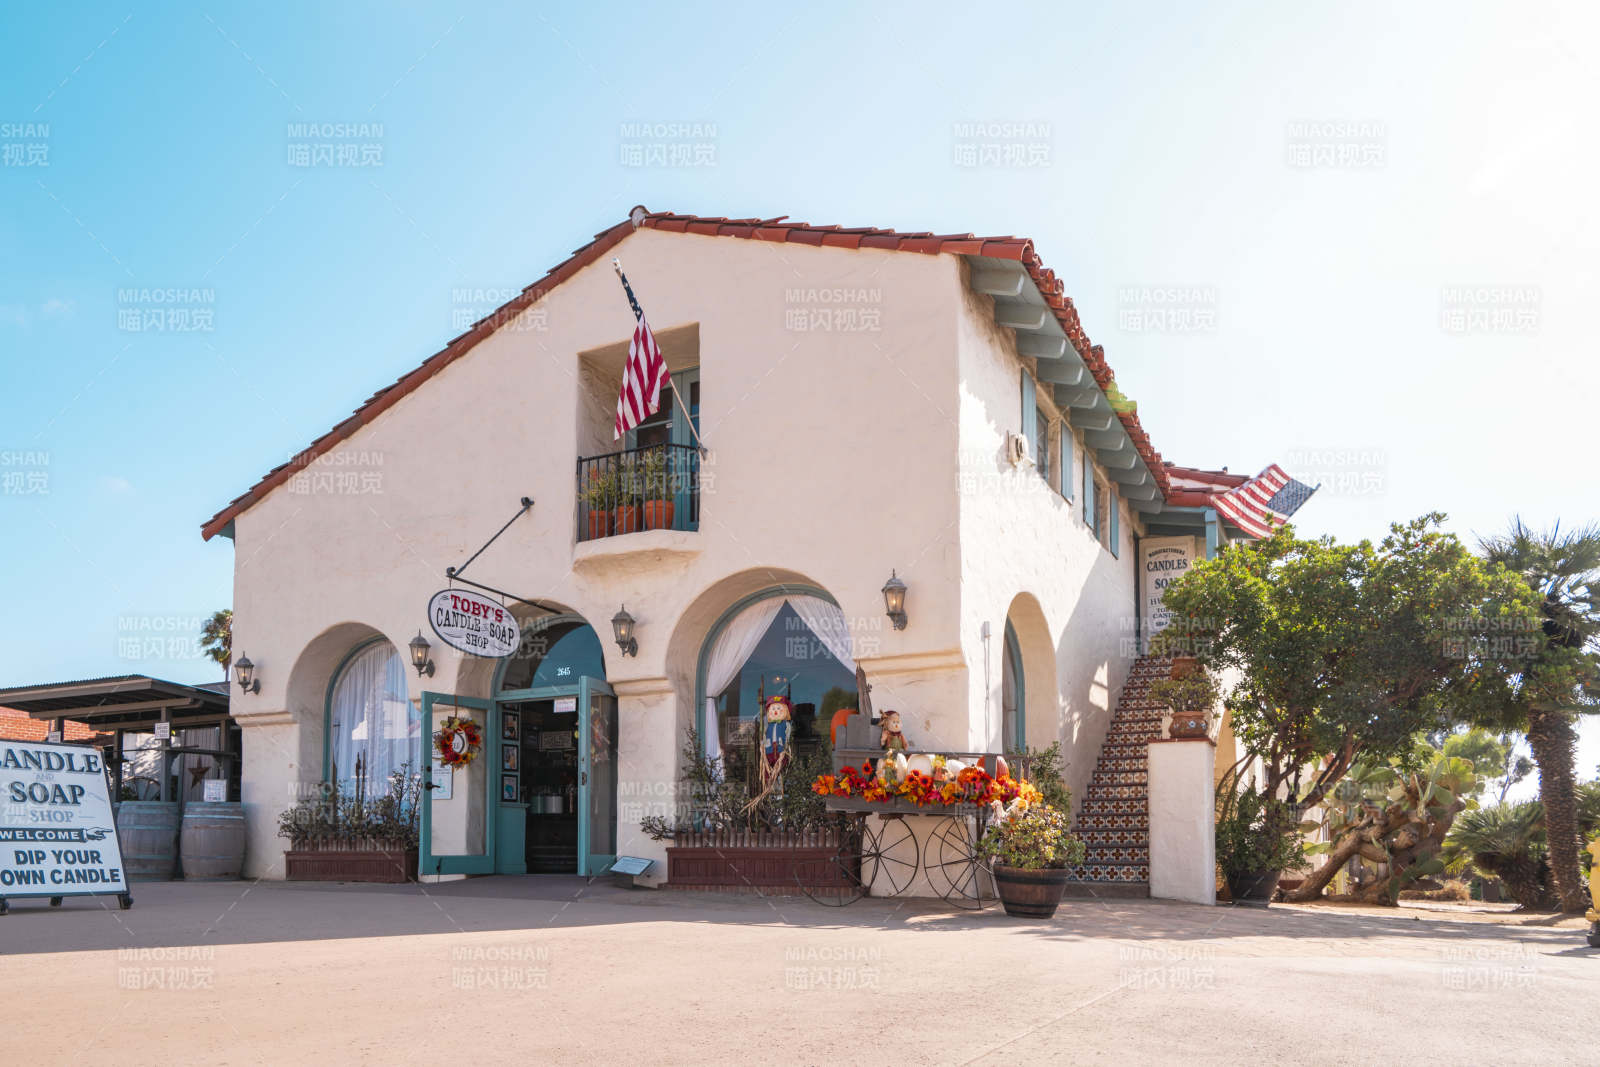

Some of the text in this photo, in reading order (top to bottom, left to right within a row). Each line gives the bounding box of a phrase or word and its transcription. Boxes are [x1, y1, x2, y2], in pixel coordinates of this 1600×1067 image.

[1147, 559, 1188, 572] CANDLES
[450, 594, 504, 623] TOBY'S
[436, 607, 481, 633] CANDLE
[489, 622, 515, 647] SOAP
[465, 632, 489, 649] SHOP
[0, 748, 102, 774] ANDLE
[9, 780, 85, 806] SOAP
[30, 810, 74, 823] SHOP
[0, 829, 80, 841] WELCOME
[14, 849, 103, 865] DIP YOUR
[0, 868, 121, 886] OWN CANDLE
